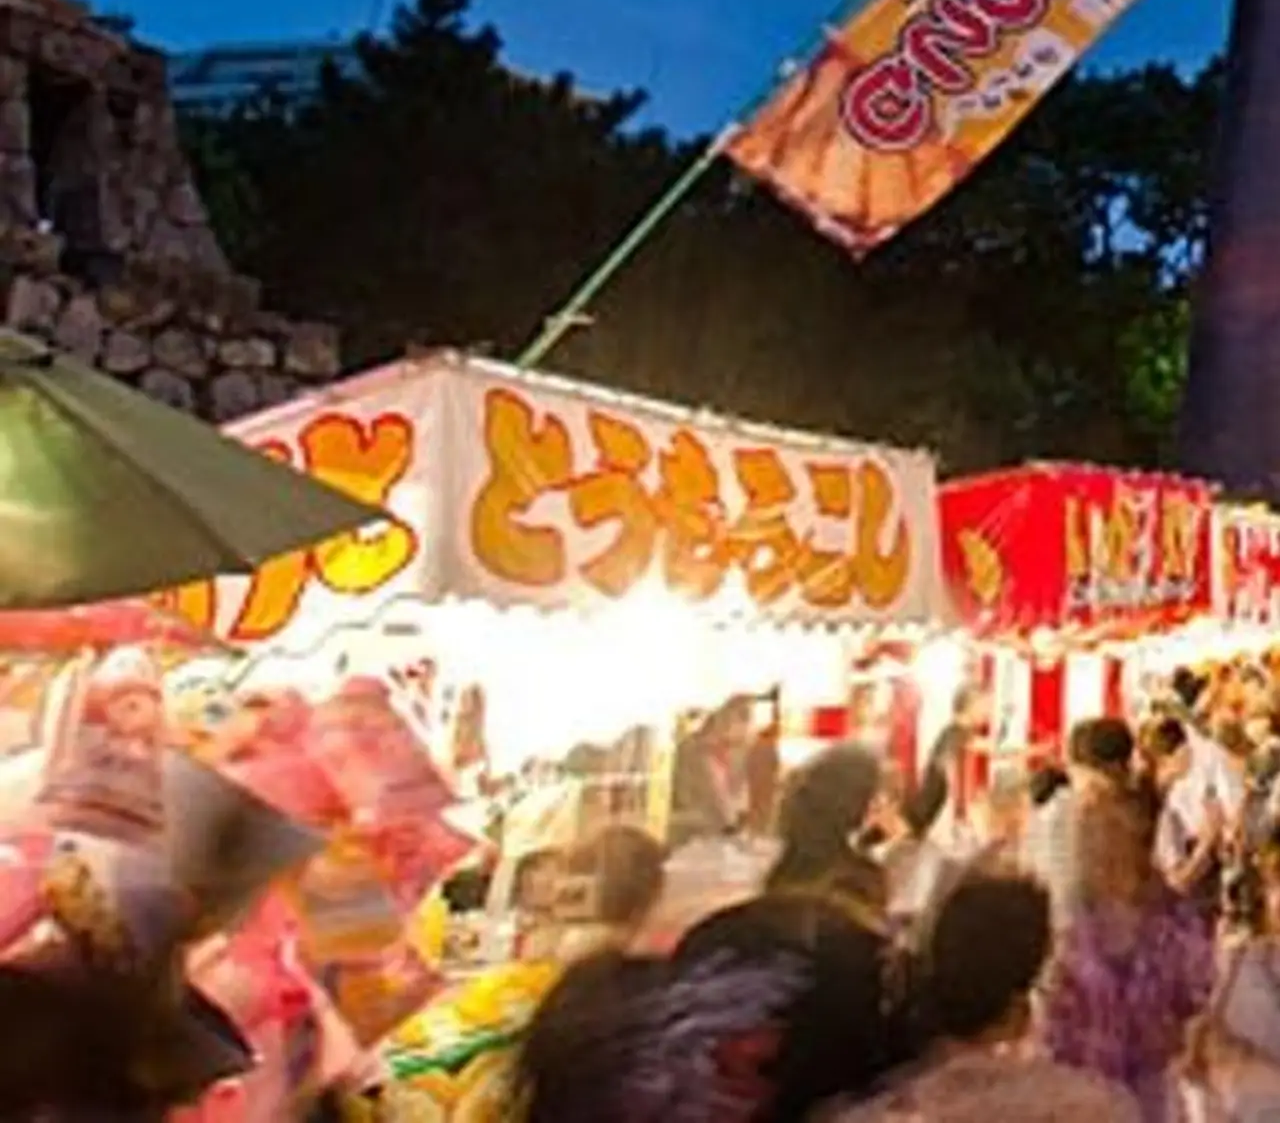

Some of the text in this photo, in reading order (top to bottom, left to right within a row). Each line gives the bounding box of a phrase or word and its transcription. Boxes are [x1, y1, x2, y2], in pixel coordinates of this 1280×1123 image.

[471, 387, 911, 609] とうもろこし
